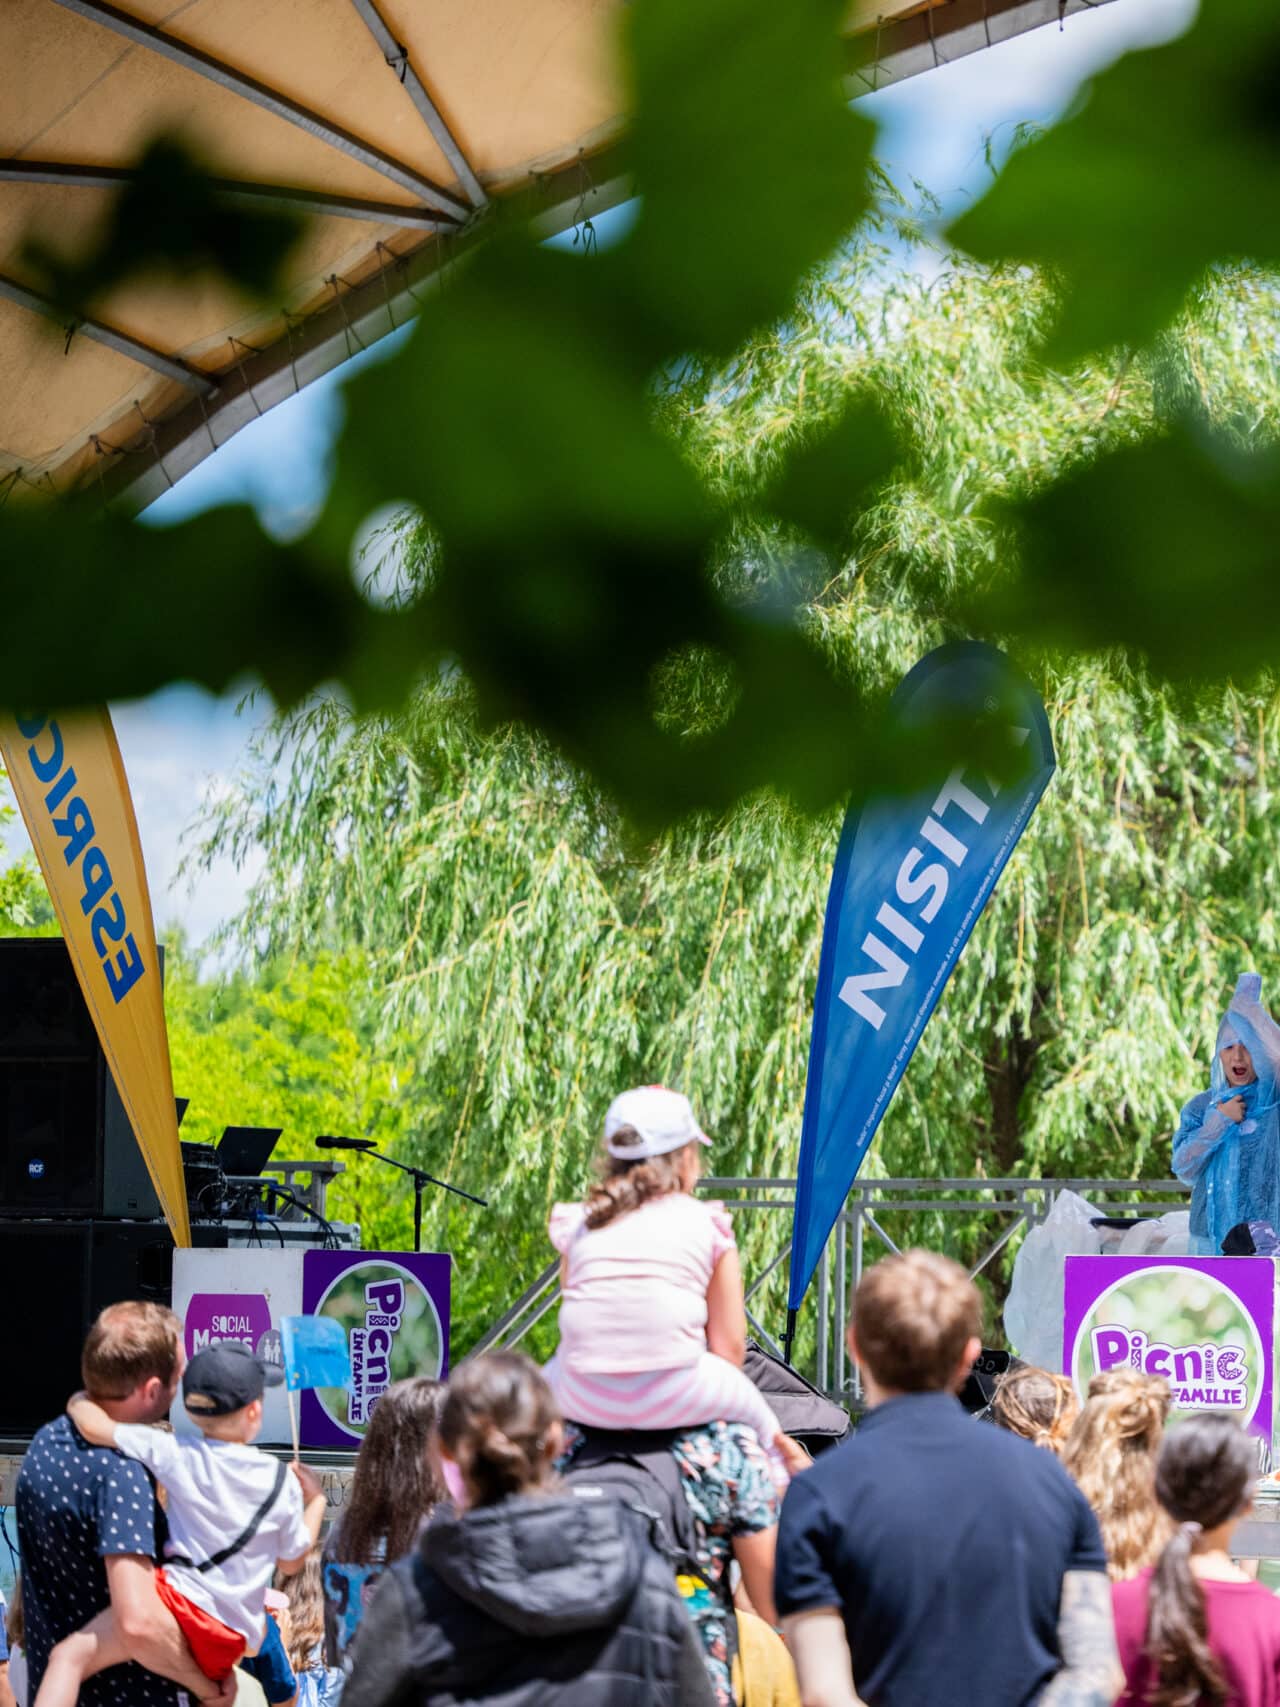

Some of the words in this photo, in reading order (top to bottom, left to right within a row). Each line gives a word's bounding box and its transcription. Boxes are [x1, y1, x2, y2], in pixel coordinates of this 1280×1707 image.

[837, 722, 1031, 1032] NISIT
[211, 1315, 253, 1334] SOCIAL
[1095, 1330, 1243, 1383] Picnic
[1171, 1387, 1242, 1404] FAMILIE
